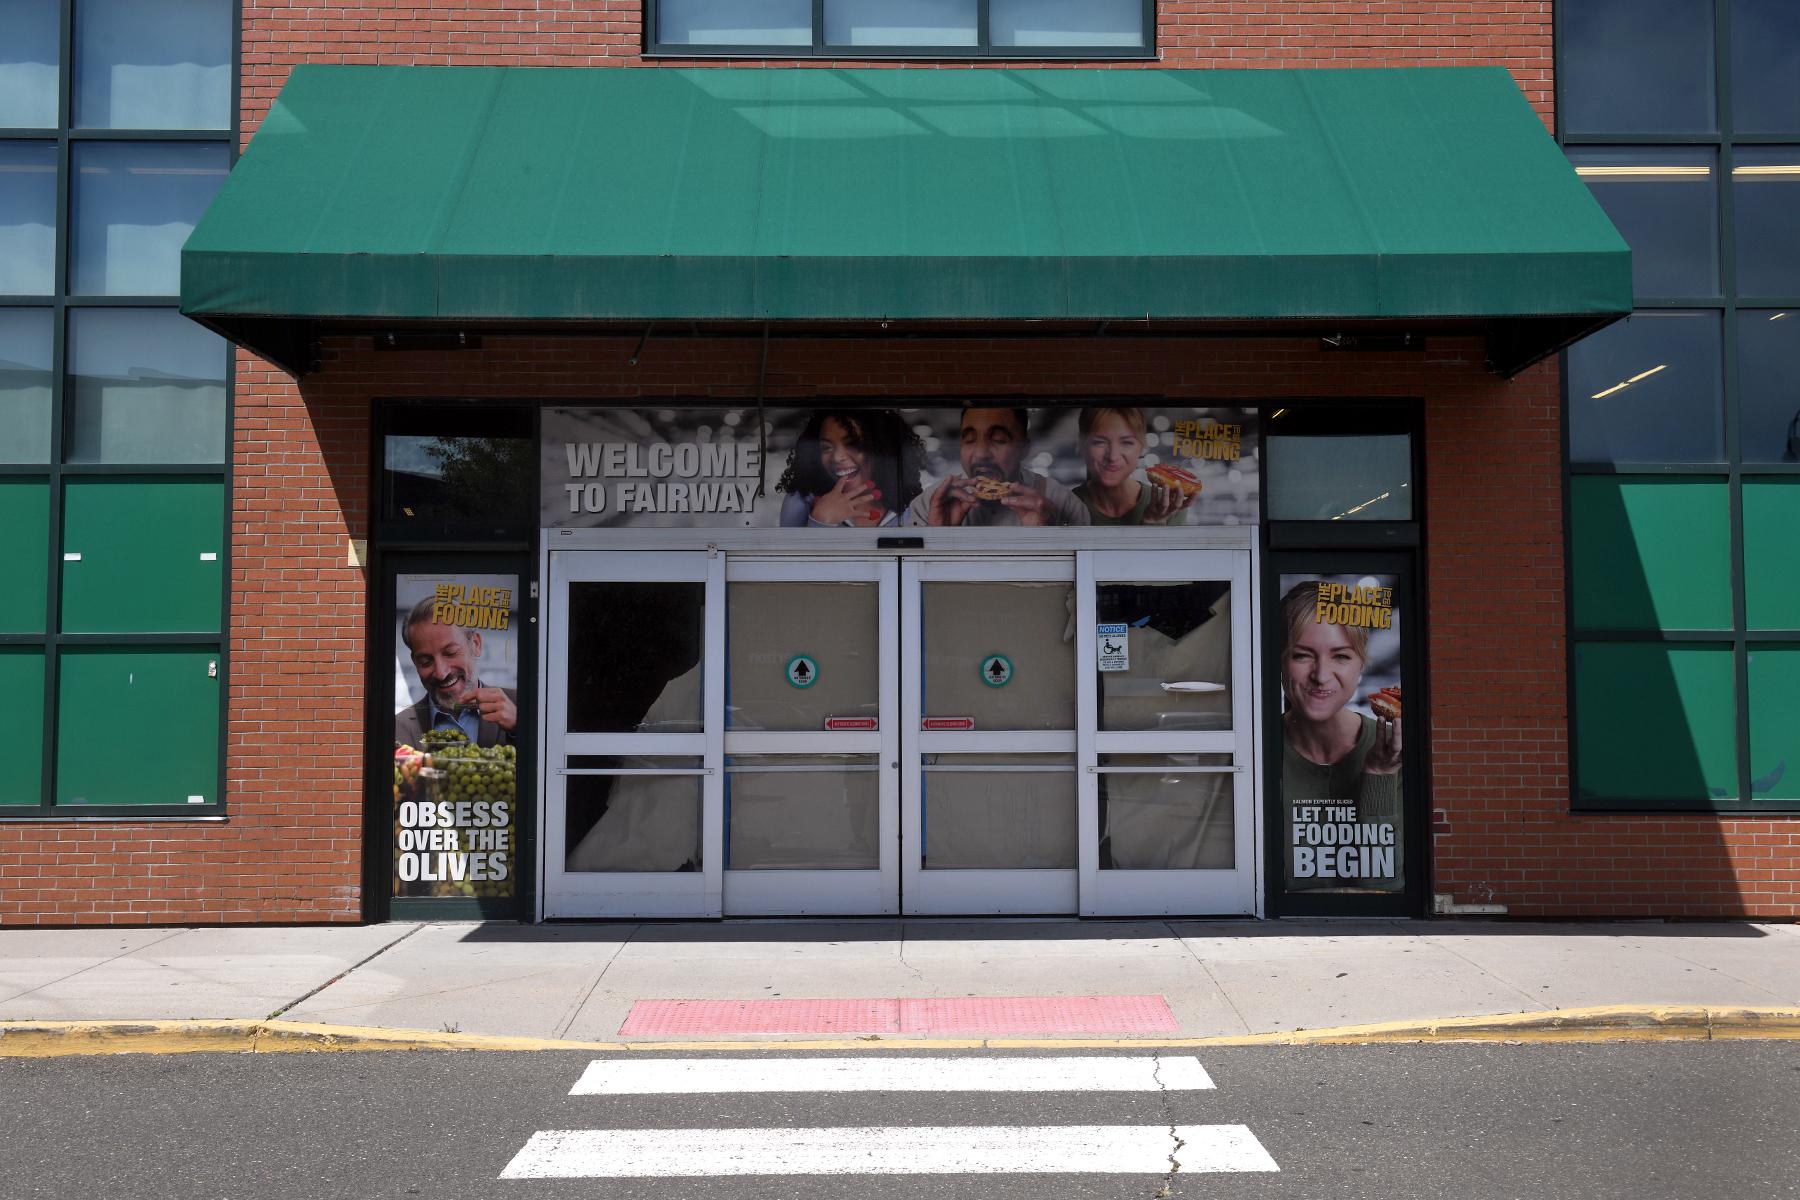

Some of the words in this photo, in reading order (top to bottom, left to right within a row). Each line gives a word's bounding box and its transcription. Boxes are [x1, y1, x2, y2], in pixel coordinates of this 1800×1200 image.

[1185, 420, 1232, 441] PLACE
[565, 442, 761, 478] WELCOME
[1173, 436, 1241, 463] FOODING
[565, 483, 607, 513] TO
[616, 483, 760, 513] FAIRWAY
[435, 584, 448, 603] THE
[447, 583, 502, 607] PLACE
[1317, 582, 1331, 602] THE
[1330, 583, 1383, 607] PLACE
[1383, 590, 1392, 598] TO
[432, 603, 510, 630] FOODING
[1316, 601, 1392, 629] FOODING
[1099, 625, 1126, 633] NOTICE
[399, 800, 510, 828] OBSESS
[1292, 806, 1321, 822] LET
[1325, 806, 1357, 822] THE
[398, 829, 459, 851] OVER
[465, 829, 509, 851] THE
[1292, 823, 1395, 846] FOODING
[398, 851, 508, 882] OLIVES
[1293, 846, 1395, 878] BEGIN
